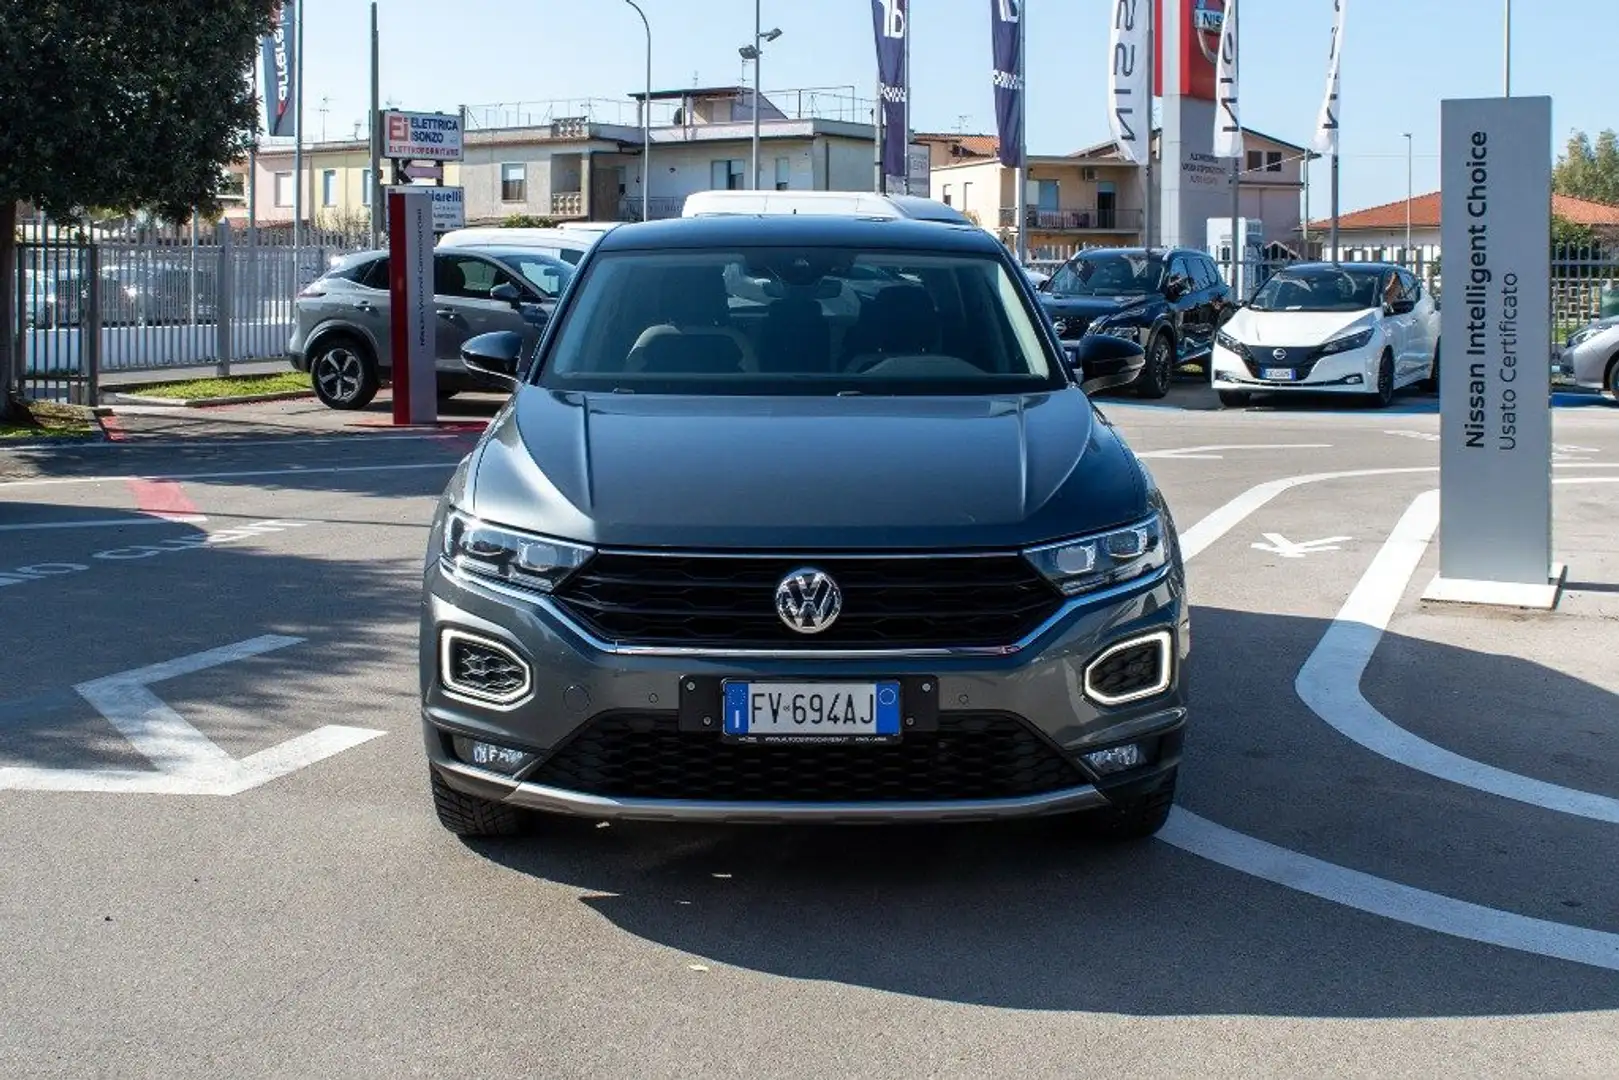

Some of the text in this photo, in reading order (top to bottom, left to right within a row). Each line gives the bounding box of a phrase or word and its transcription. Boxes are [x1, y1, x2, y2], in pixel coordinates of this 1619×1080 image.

[1202, 12, 1222, 29] NIS
[410, 117, 459, 132] ELETTRICA
[1464, 131, 1492, 448] Nissan Intelligent Choice
[1499, 272, 1518, 451] Usato Certificato
